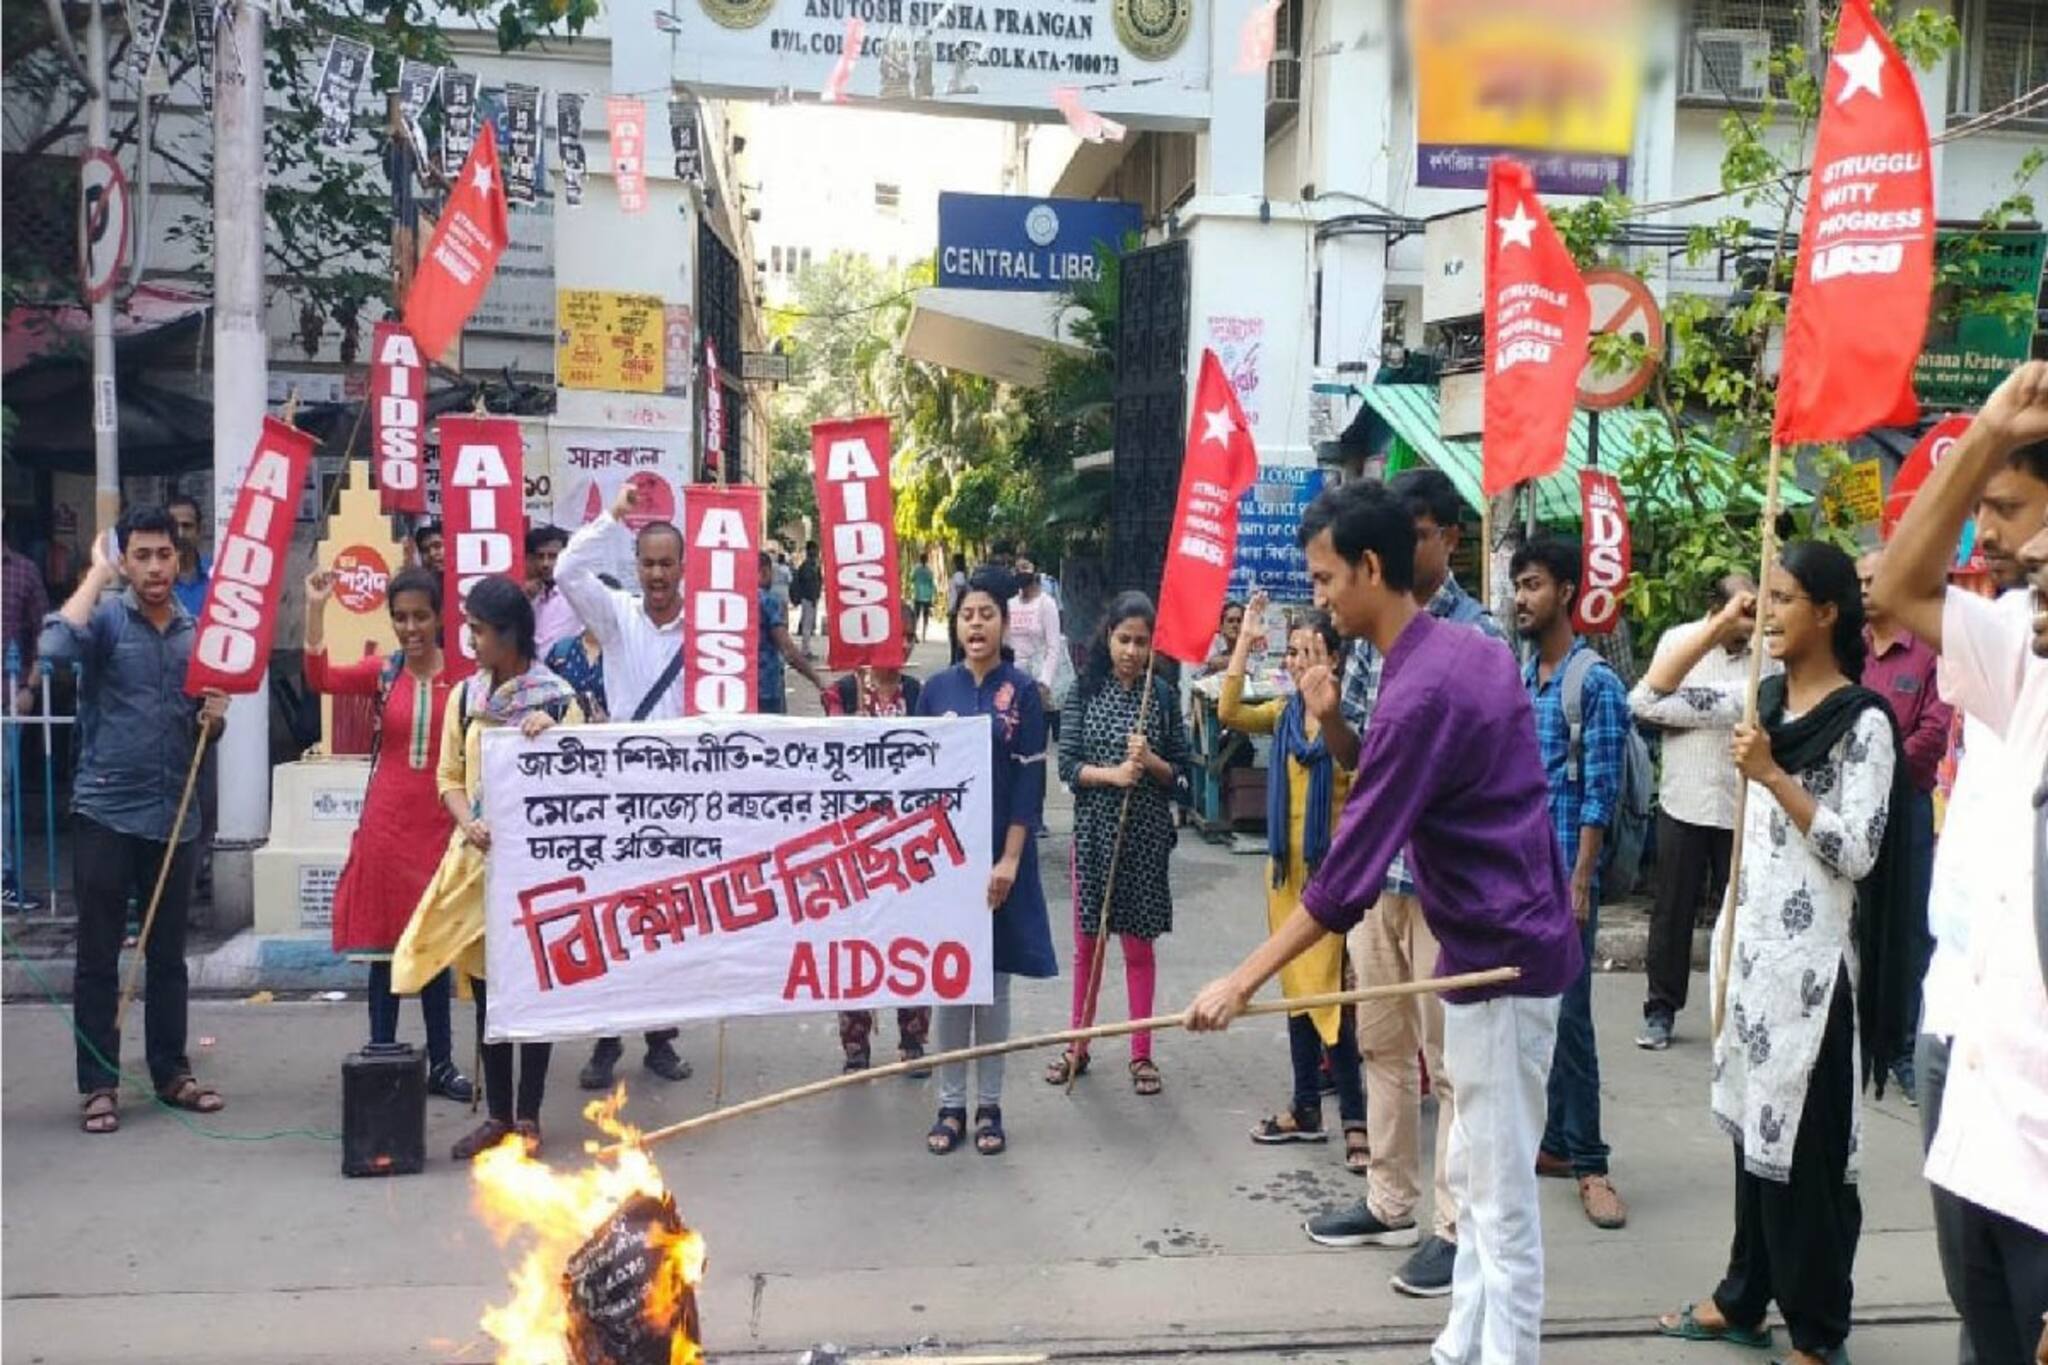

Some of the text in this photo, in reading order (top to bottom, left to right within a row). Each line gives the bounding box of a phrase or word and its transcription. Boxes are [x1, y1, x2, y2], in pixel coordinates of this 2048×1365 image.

[805, 0, 902, 23] ASUTOSH
[995, 8, 1093, 39] PRANGAN
[943, 246, 1041, 279] CENTRAL
[379, 334, 422, 491] AIDSO
[196, 450, 291, 675] AIDSO
[826, 438, 891, 645] AIDSO
[694, 508, 750, 714] AIDSO
[518, 737, 607, 779] জাতীয়
[613, 735, 690, 773] শিক্ষা
[523, 793, 611, 828] মেনে
[616, 792, 704, 824] রাজ্যে
[706, 791, 723, 822] ৪
[728, 791, 814, 823] বছরের
[527, 825, 723, 872] চালুর প্রতিবাদে
[514, 798, 967, 992] বিক্ষোভ মিছিল
[783, 939, 971, 1001] AIDSO
